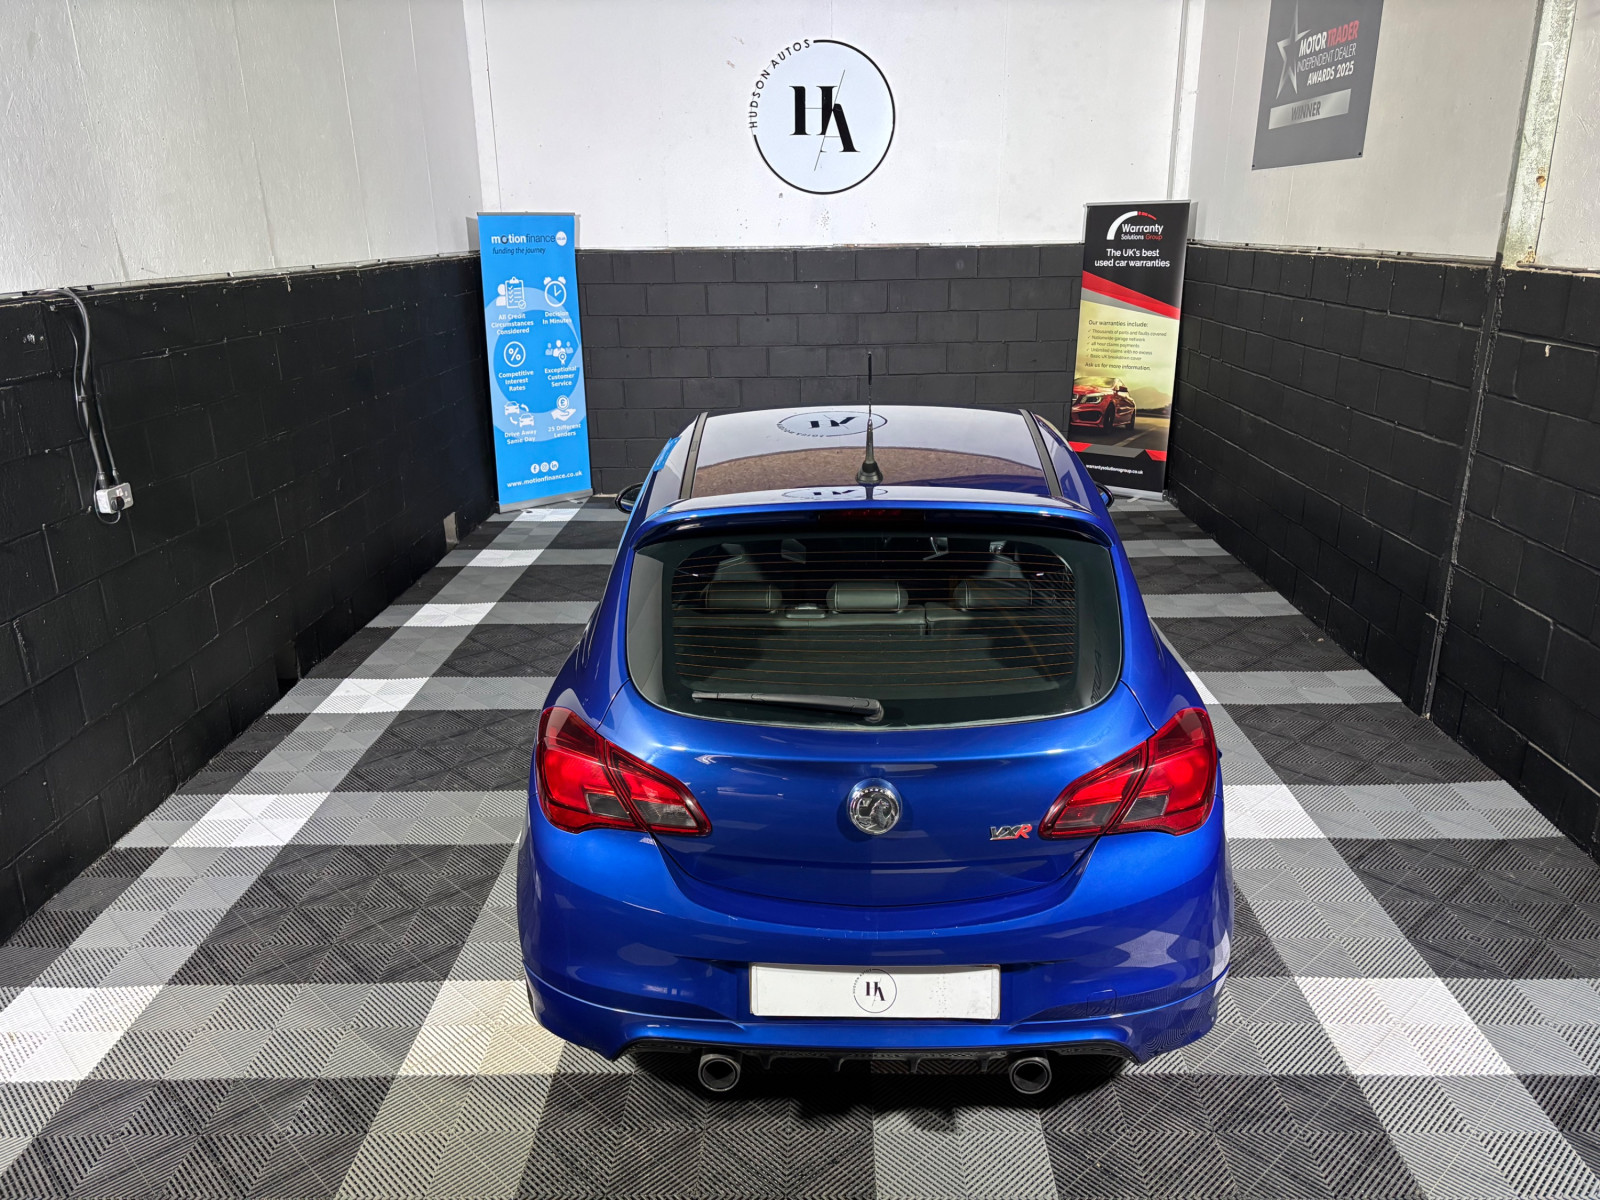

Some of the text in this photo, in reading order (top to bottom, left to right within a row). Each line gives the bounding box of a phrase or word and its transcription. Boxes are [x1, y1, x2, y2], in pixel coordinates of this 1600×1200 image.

[1299, 20, 1360, 57] MOTOR TRADER
[1297, 43, 1357, 72] INDEPENDENT DEALER
[1307, 61, 1354, 86] AWARDS 2025
[749, 39, 810, 129] HUDSON AUTOS
[1291, 101, 1321, 120] WINNER
[1121, 223, 1164, 235] Warranty
[492, 247, 515, 255] funding
[524, 247, 546, 255] journey
[1106, 248, 1159, 257] The UK's best
[1094, 258, 1114, 267] used
[1128, 258, 1170, 267] warranties
[491, 320, 534, 328] Circumstances
[496, 327, 530, 335] Considered
[498, 370, 534, 379] Competitive
[544, 366, 577, 374] Exceptional
[505, 377, 529, 385] Interest
[547, 373, 575, 381] Customer
[555, 423, 581, 431] Different
[521, 429, 537, 437] Away
[553, 430, 576, 438] Lenders
[507, 437, 523, 445] Same
[506, 470, 583, 488] www.motionfinance.co.uk
[989, 823, 1033, 841] VXR
